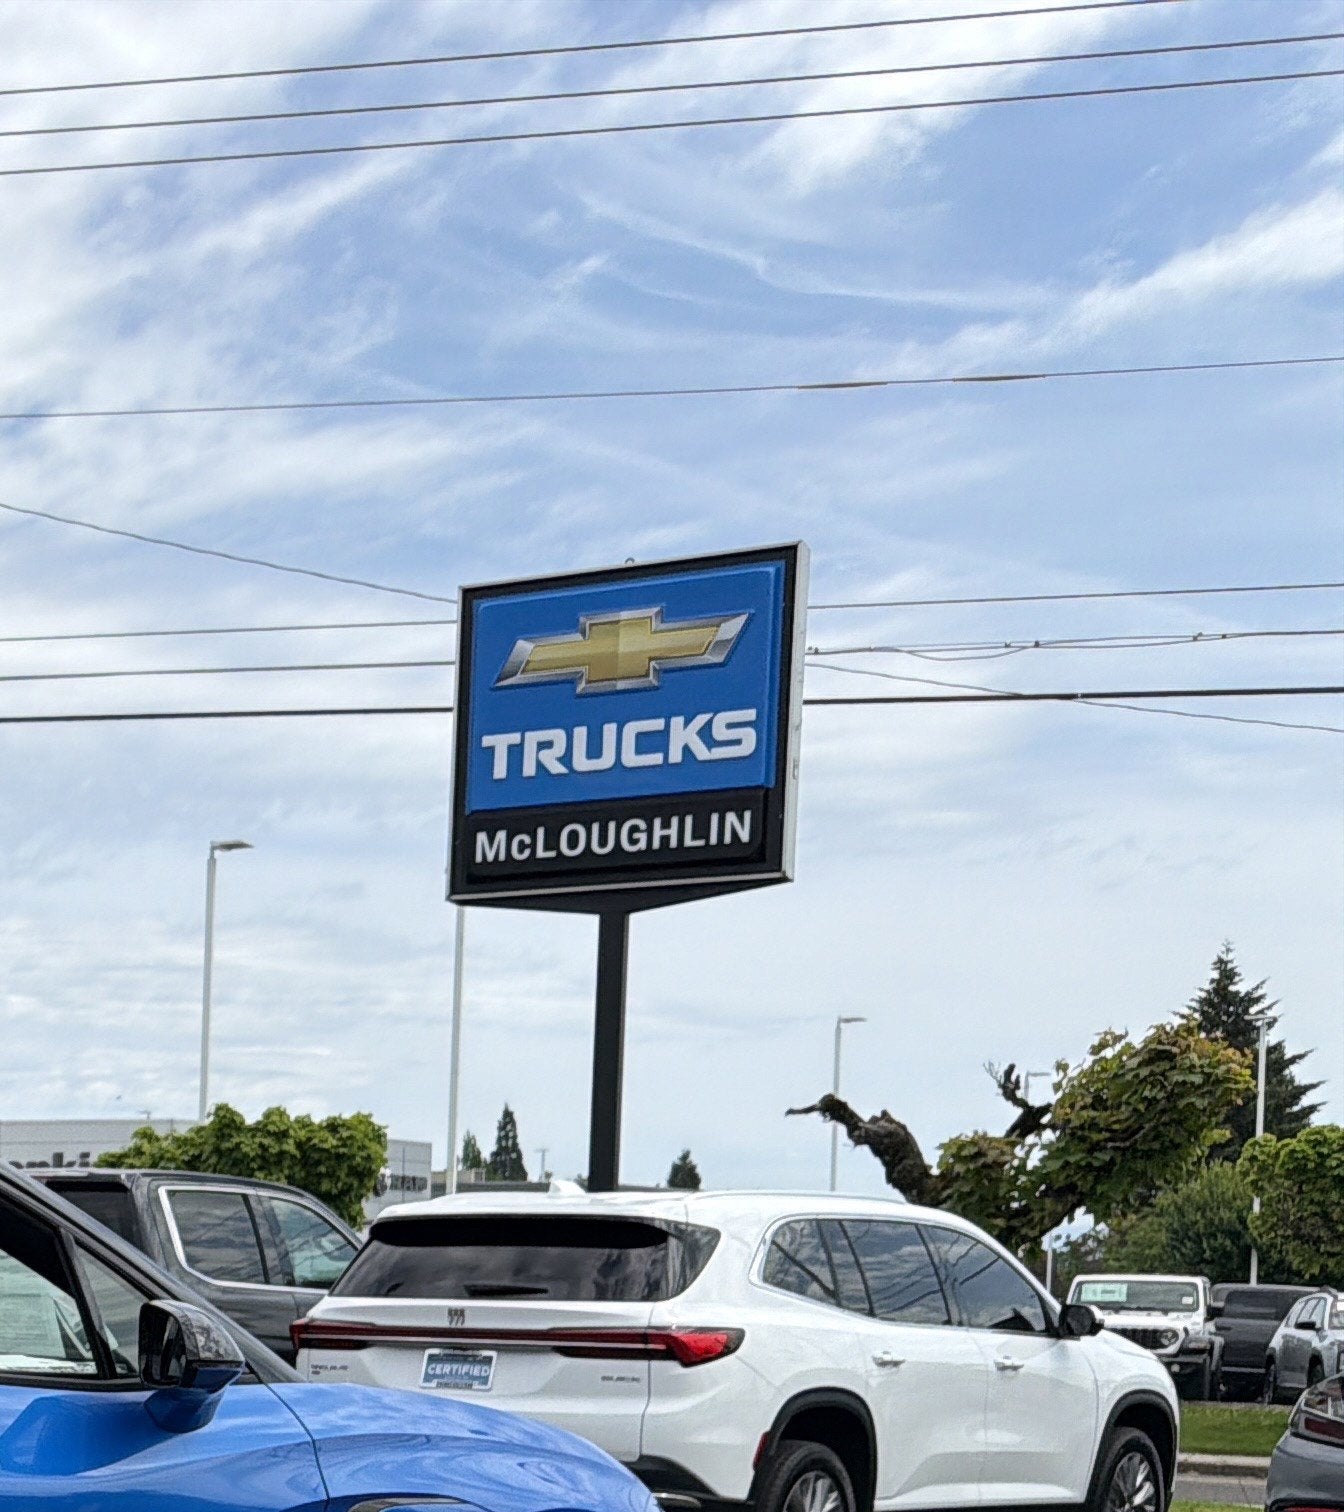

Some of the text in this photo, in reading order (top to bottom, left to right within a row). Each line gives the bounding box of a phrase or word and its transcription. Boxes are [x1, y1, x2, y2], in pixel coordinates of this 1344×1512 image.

[481, 708, 757, 781] TRUCKS
[474, 810, 752, 864] McLOUGHLIN
[427, 1363, 490, 1378] CERTIFIED
